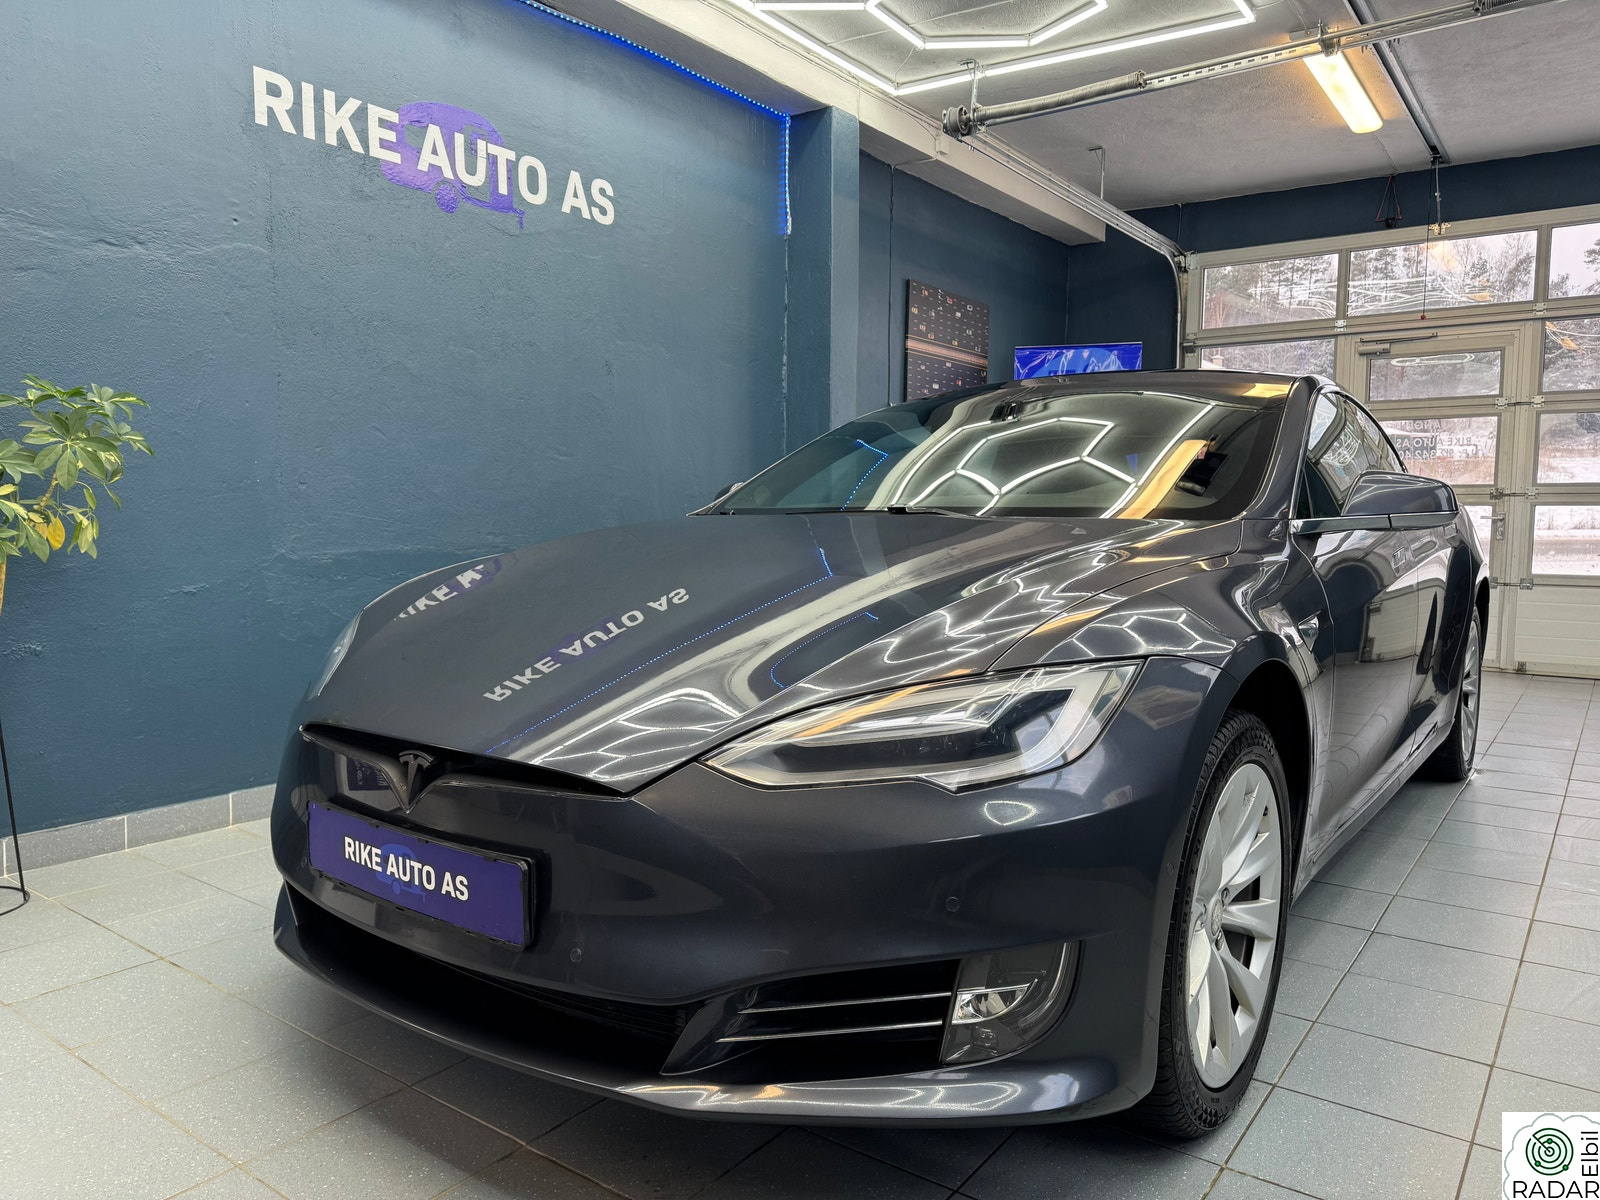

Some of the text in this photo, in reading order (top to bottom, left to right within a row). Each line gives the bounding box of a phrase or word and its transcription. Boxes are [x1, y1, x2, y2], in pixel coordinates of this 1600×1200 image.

[252, 65, 615, 226] RIKE AUTO AS
[344, 836, 469, 901] RIKE AUTO AS
